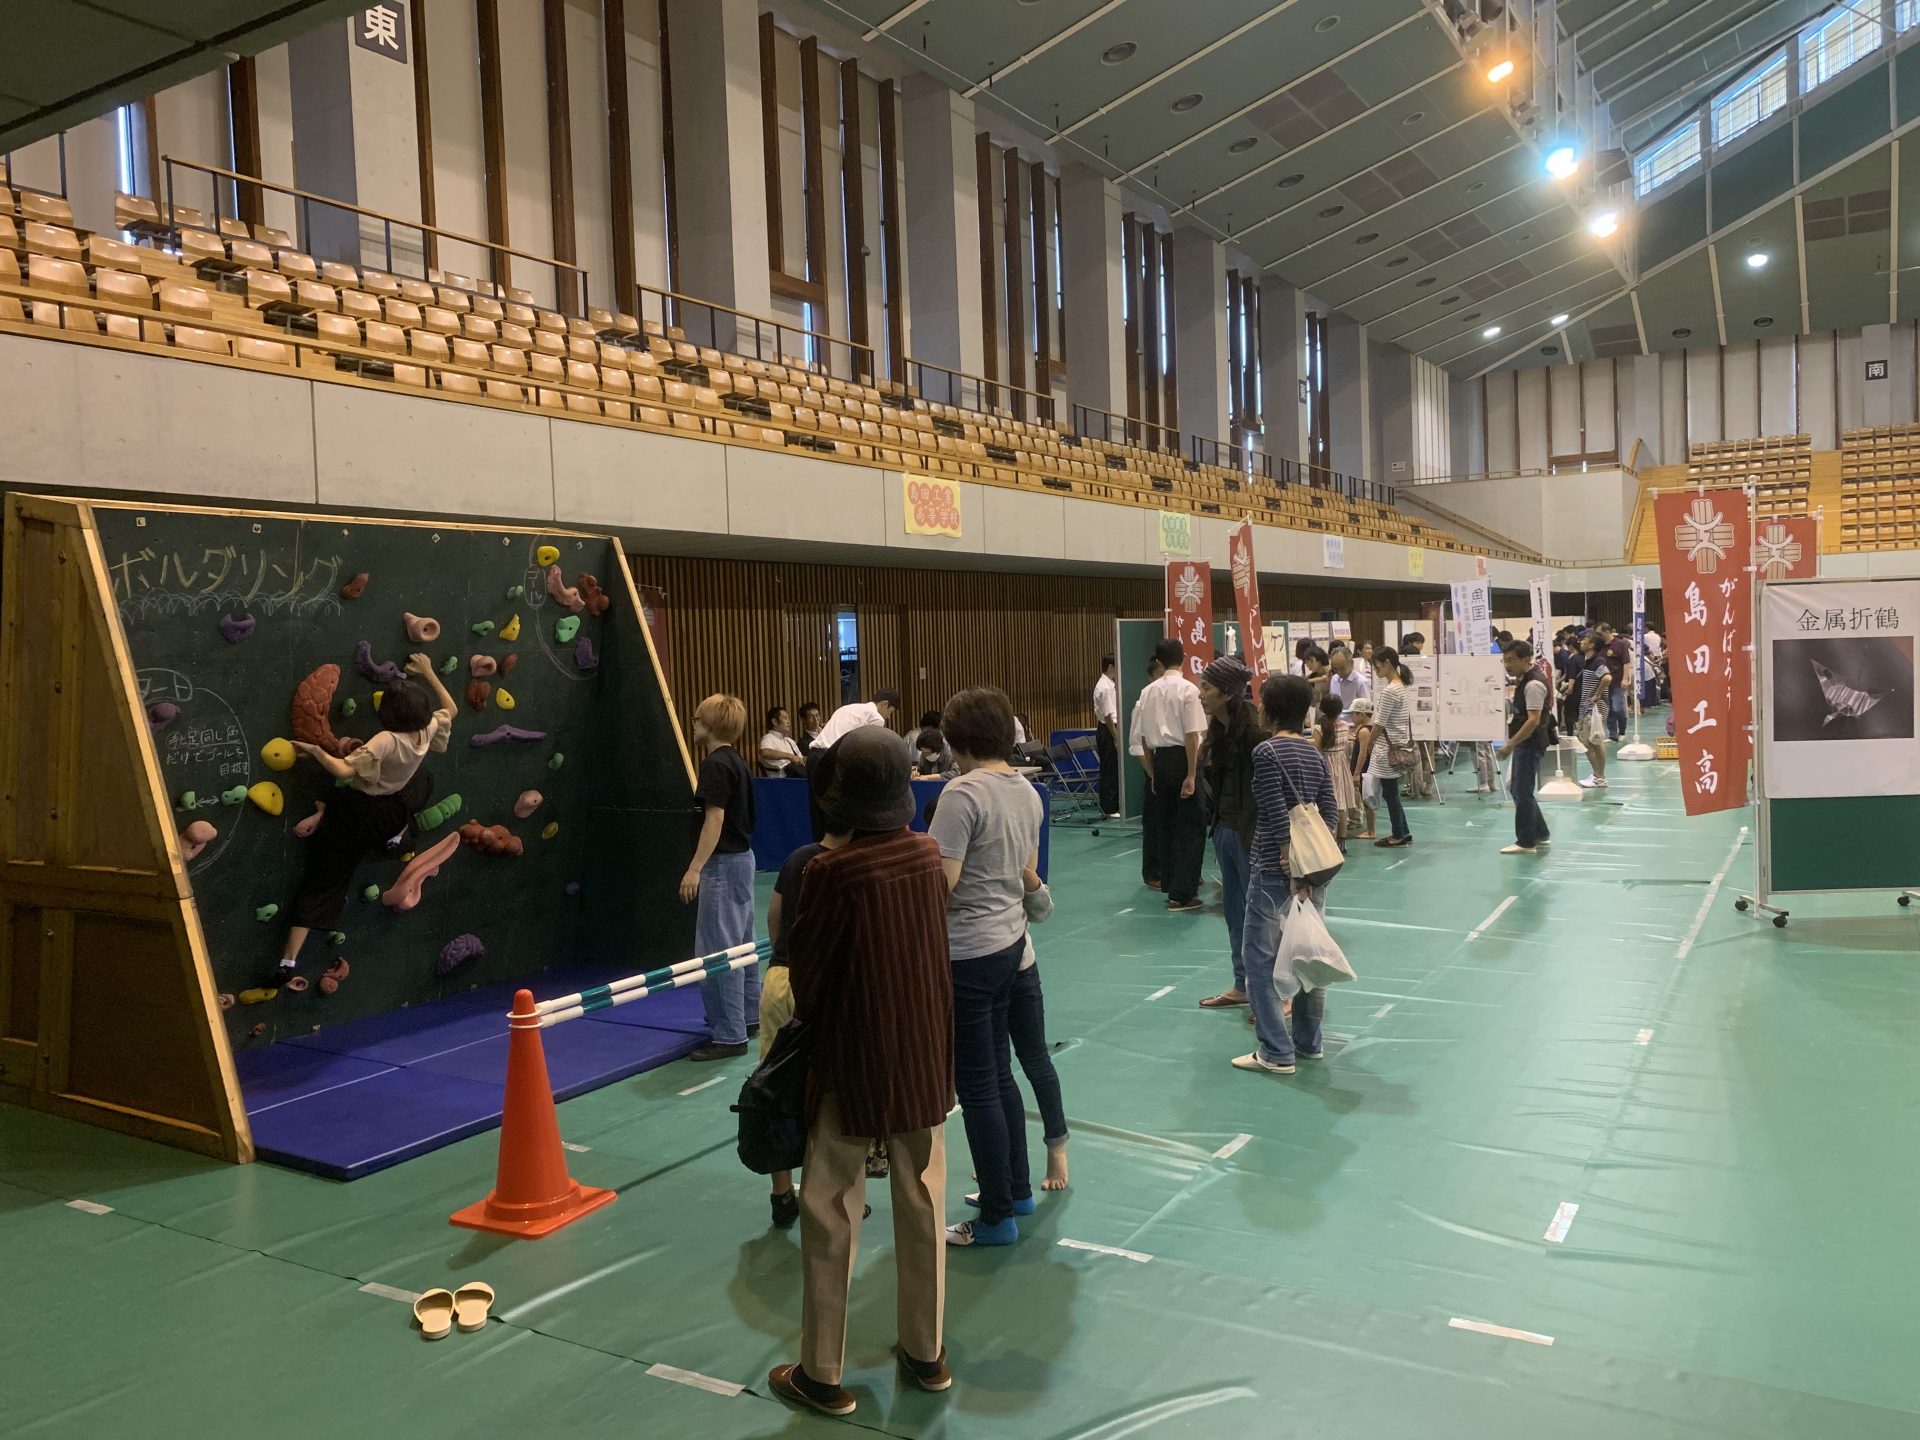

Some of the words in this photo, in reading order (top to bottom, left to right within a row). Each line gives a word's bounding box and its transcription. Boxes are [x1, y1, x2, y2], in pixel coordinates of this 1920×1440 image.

[363, 4, 400, 50] 東
[1868, 363, 1884, 378] 南
[109, 547, 342, 605] ボルダリング
[1719, 577, 1738, 711] がんばろう
[1795, 606, 1900, 632] 金属折鶴
[1684, 581, 1718, 794] 島田工高
